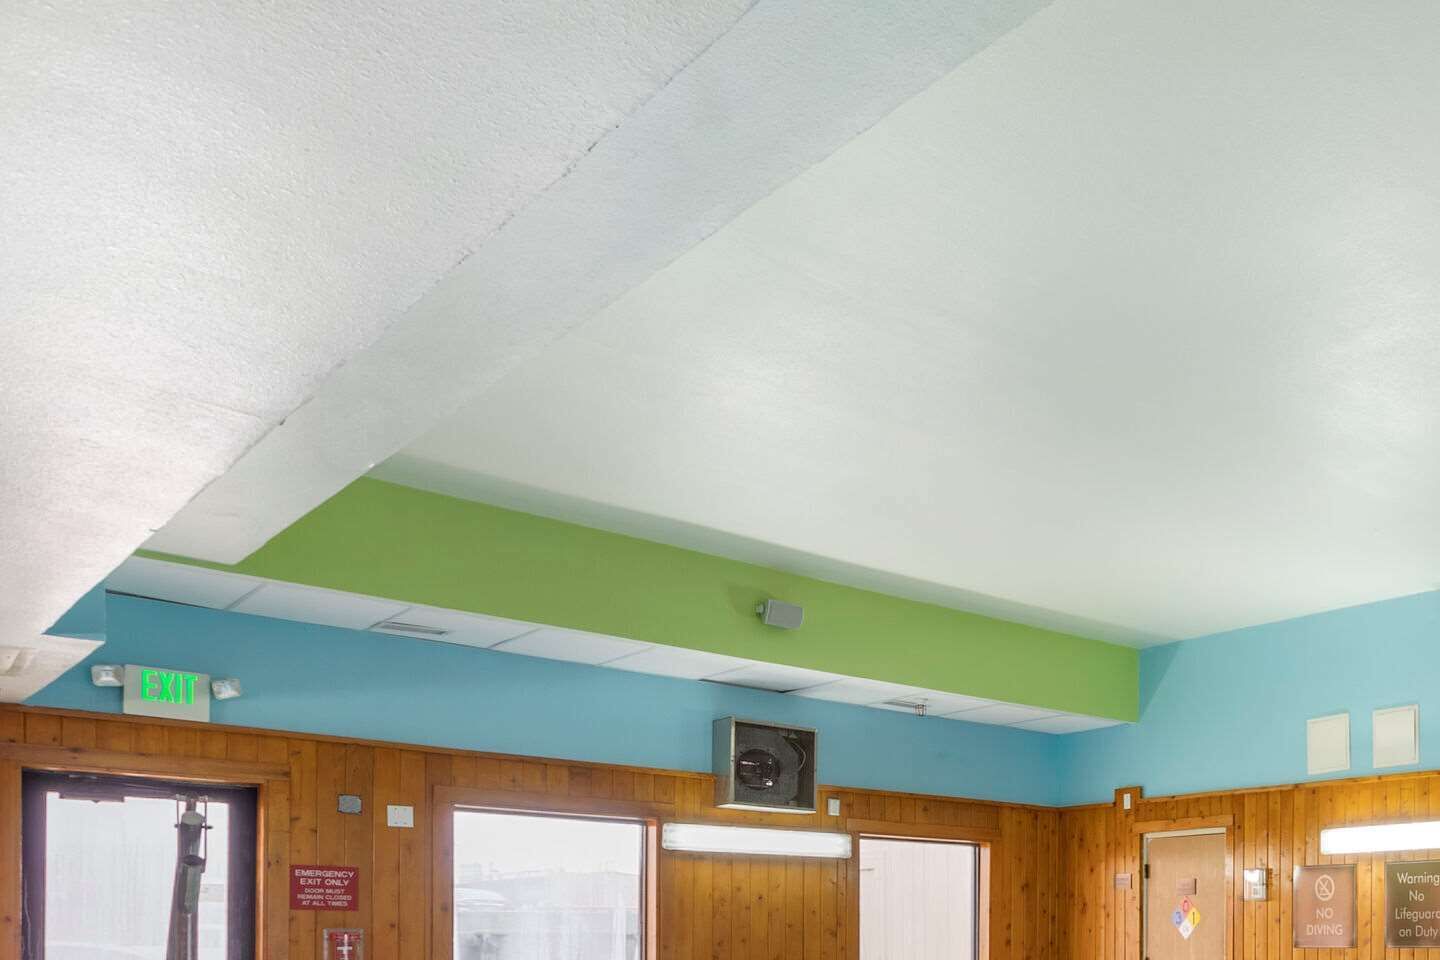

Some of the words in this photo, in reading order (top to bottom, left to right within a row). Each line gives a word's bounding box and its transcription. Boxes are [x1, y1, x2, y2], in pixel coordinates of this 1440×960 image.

[142, 670, 198, 704] EXIT
[295, 869, 354, 878] EMERGENCY
[1396, 872, 1440, 886] Warning
[325, 878, 349, 886] ONLY
[1408, 890, 1425, 902] No
[1315, 908, 1334, 919] NO
[1306, 924, 1344, 936] DIVING
[1398, 928, 1412, 937] on
[1415, 925, 1439, 939] Duty
